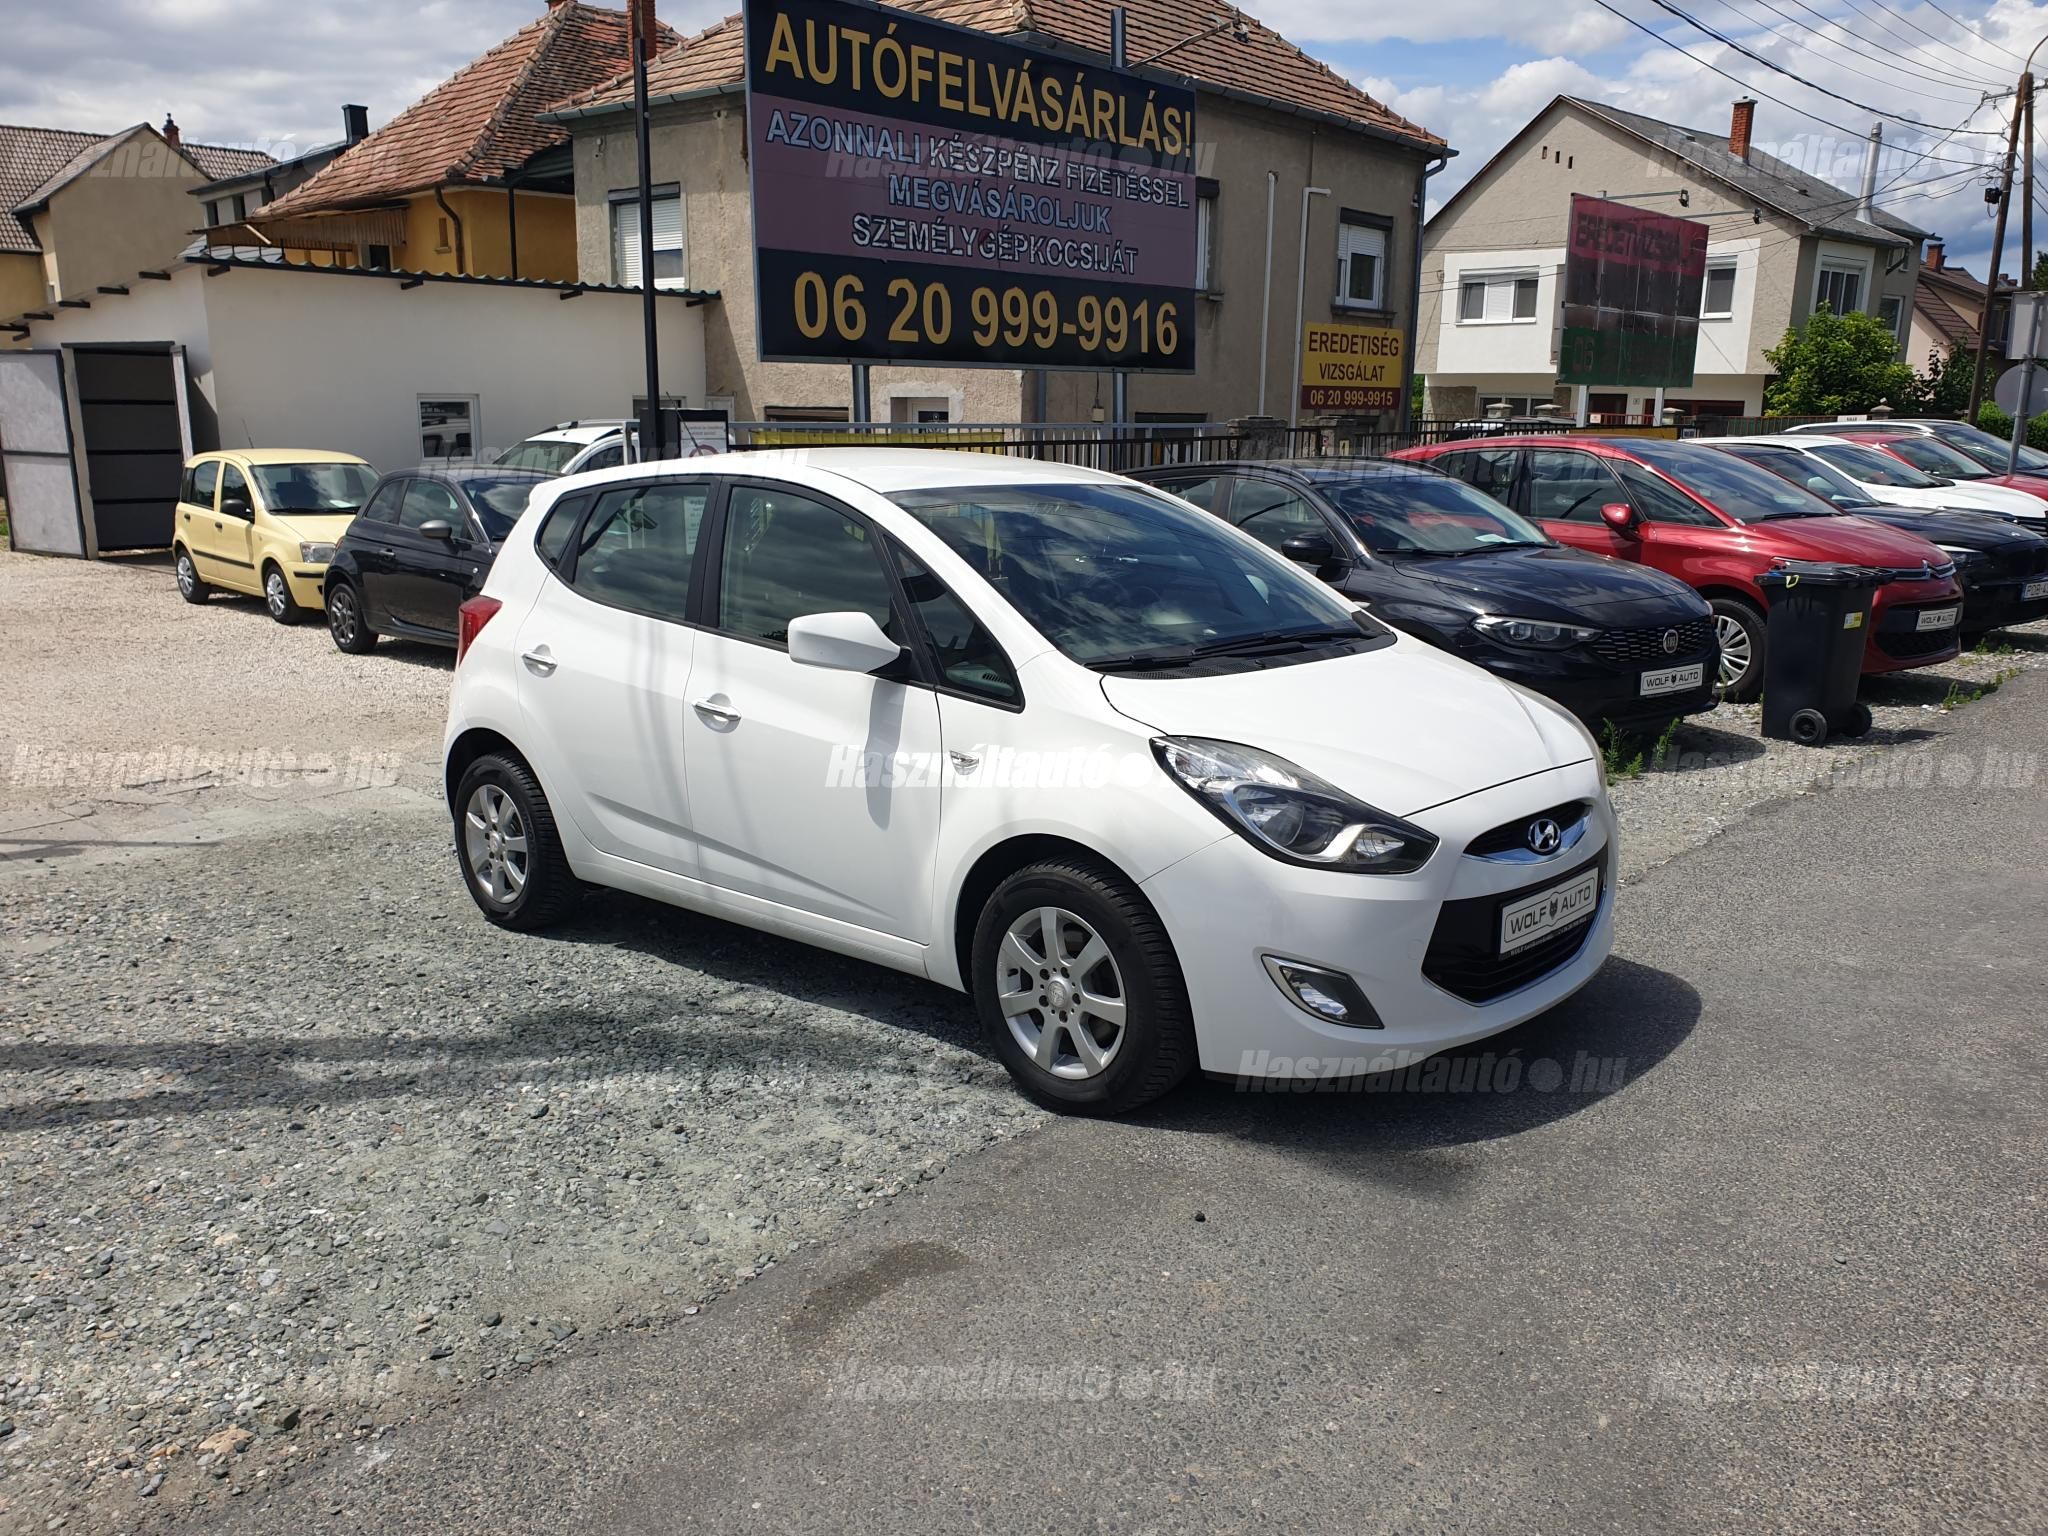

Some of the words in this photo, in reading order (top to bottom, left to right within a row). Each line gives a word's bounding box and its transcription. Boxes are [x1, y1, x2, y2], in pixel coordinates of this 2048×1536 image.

[765, 12, 1191, 158] AUTÓFELVÁSÁRLÁS!
[766, 109, 921, 165] AZONNALI
[929, 133, 1060, 187] KÉSZPÉNZ
[1066, 162, 1190, 208] FIZETÉSSEL
[889, 175, 1113, 235] MEGVÁSÁROLJUK
[852, 213, 1138, 275] SZEMÉLYGÉPKOCSIJÁT
[794, 271, 867, 342] 06
[888, 279, 952, 345] 20
[971, 286, 1178, 355] 999-9916
[1309, 331, 1399, 357] EREDETISÉG
[1319, 360, 1385, 382] VIZSGÁLAT
[1310, 389, 1325, 406] 06
[1327, 389, 1341, 406] 20
[1344, 390, 1393, 407] 999-9915
[1646, 676, 1669, 687] WOLF
[1679, 672, 1698, 682] AUTO
[1510, 905, 1547, 934] WOLF
[1561, 885, 1591, 913] AUTO
